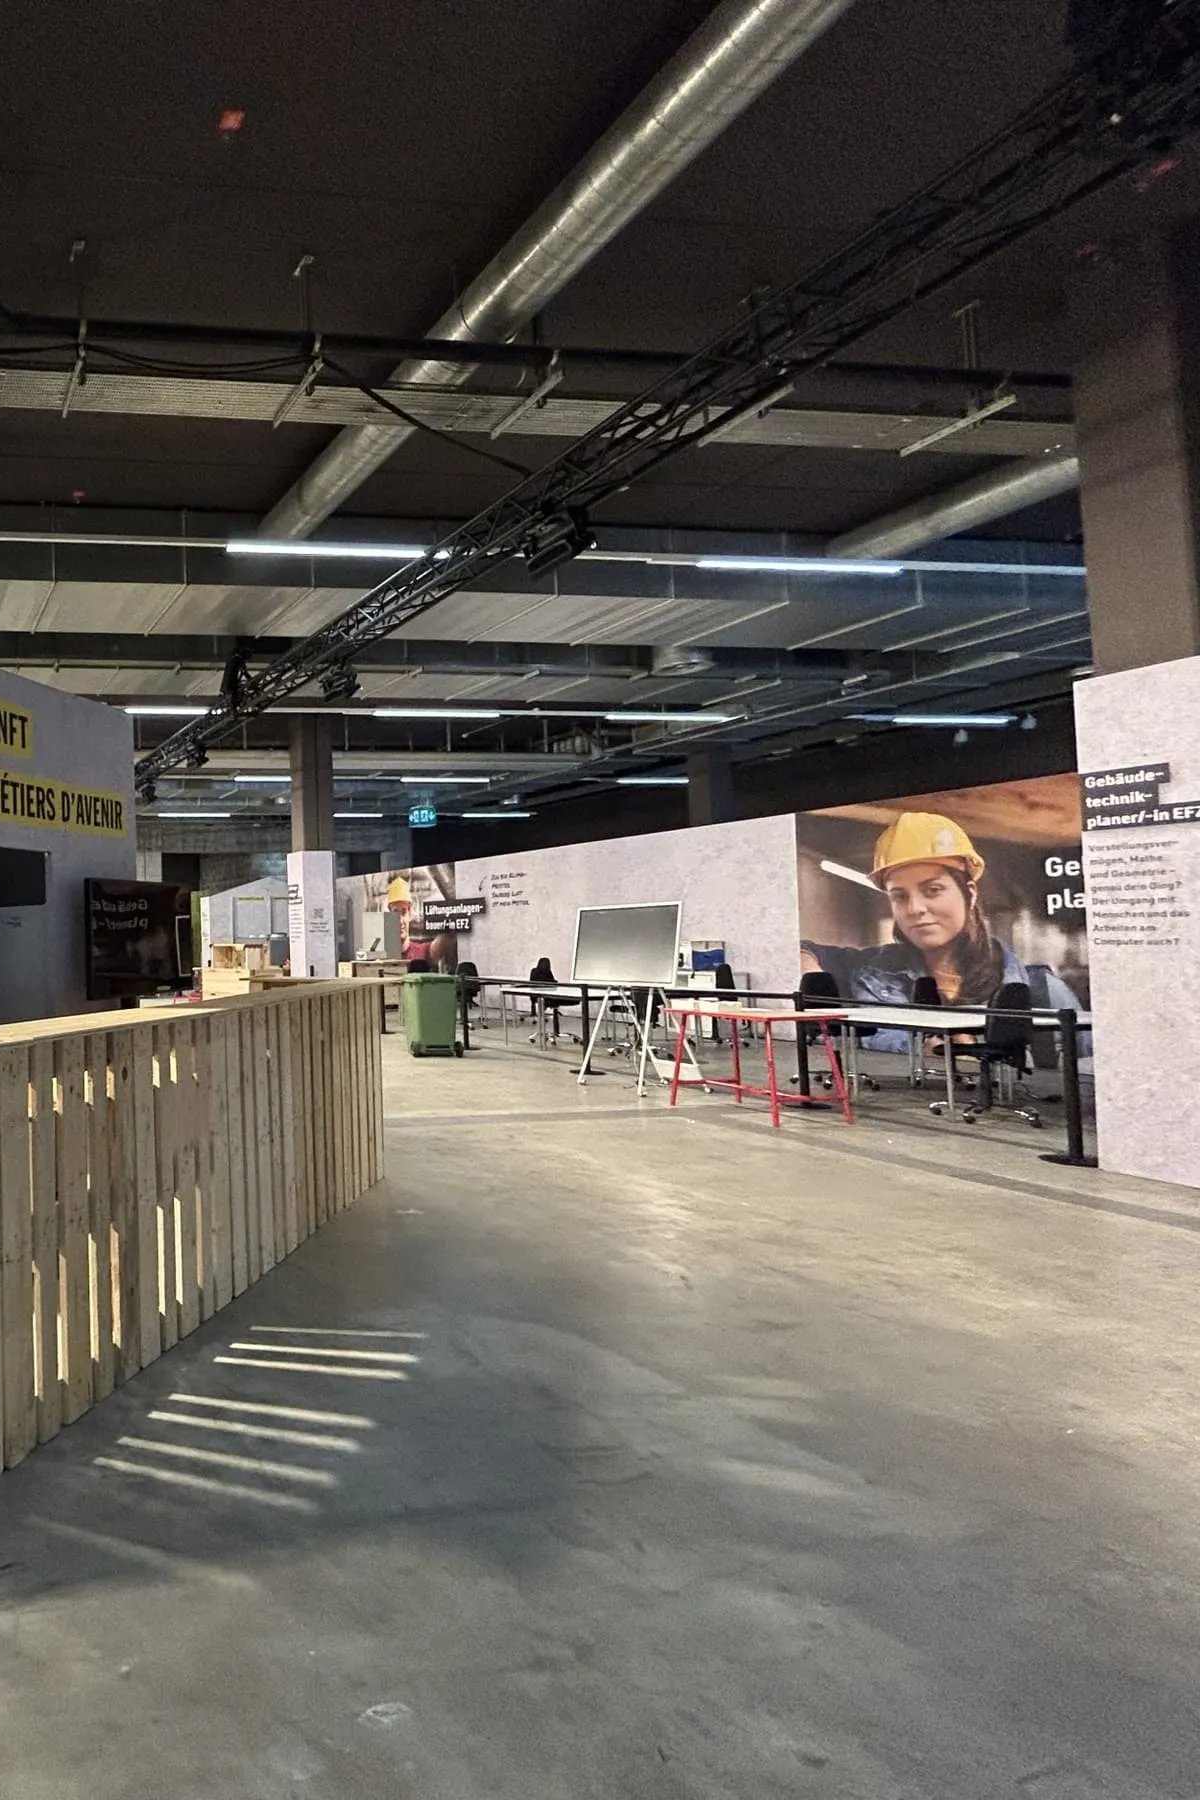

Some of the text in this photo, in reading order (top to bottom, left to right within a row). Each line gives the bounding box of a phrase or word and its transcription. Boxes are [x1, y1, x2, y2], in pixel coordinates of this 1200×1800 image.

[1085, 770, 1164, 788] Gebäude-
[1085, 791, 1152, 808] technik-
[61, 790, 123, 830] D'AVENIR
[1087, 809, 1170, 829] planer/-in
[425, 903, 483, 917] Lüftungsanlagen-
[425, 918, 469, 931] bauer/-in EFZ
